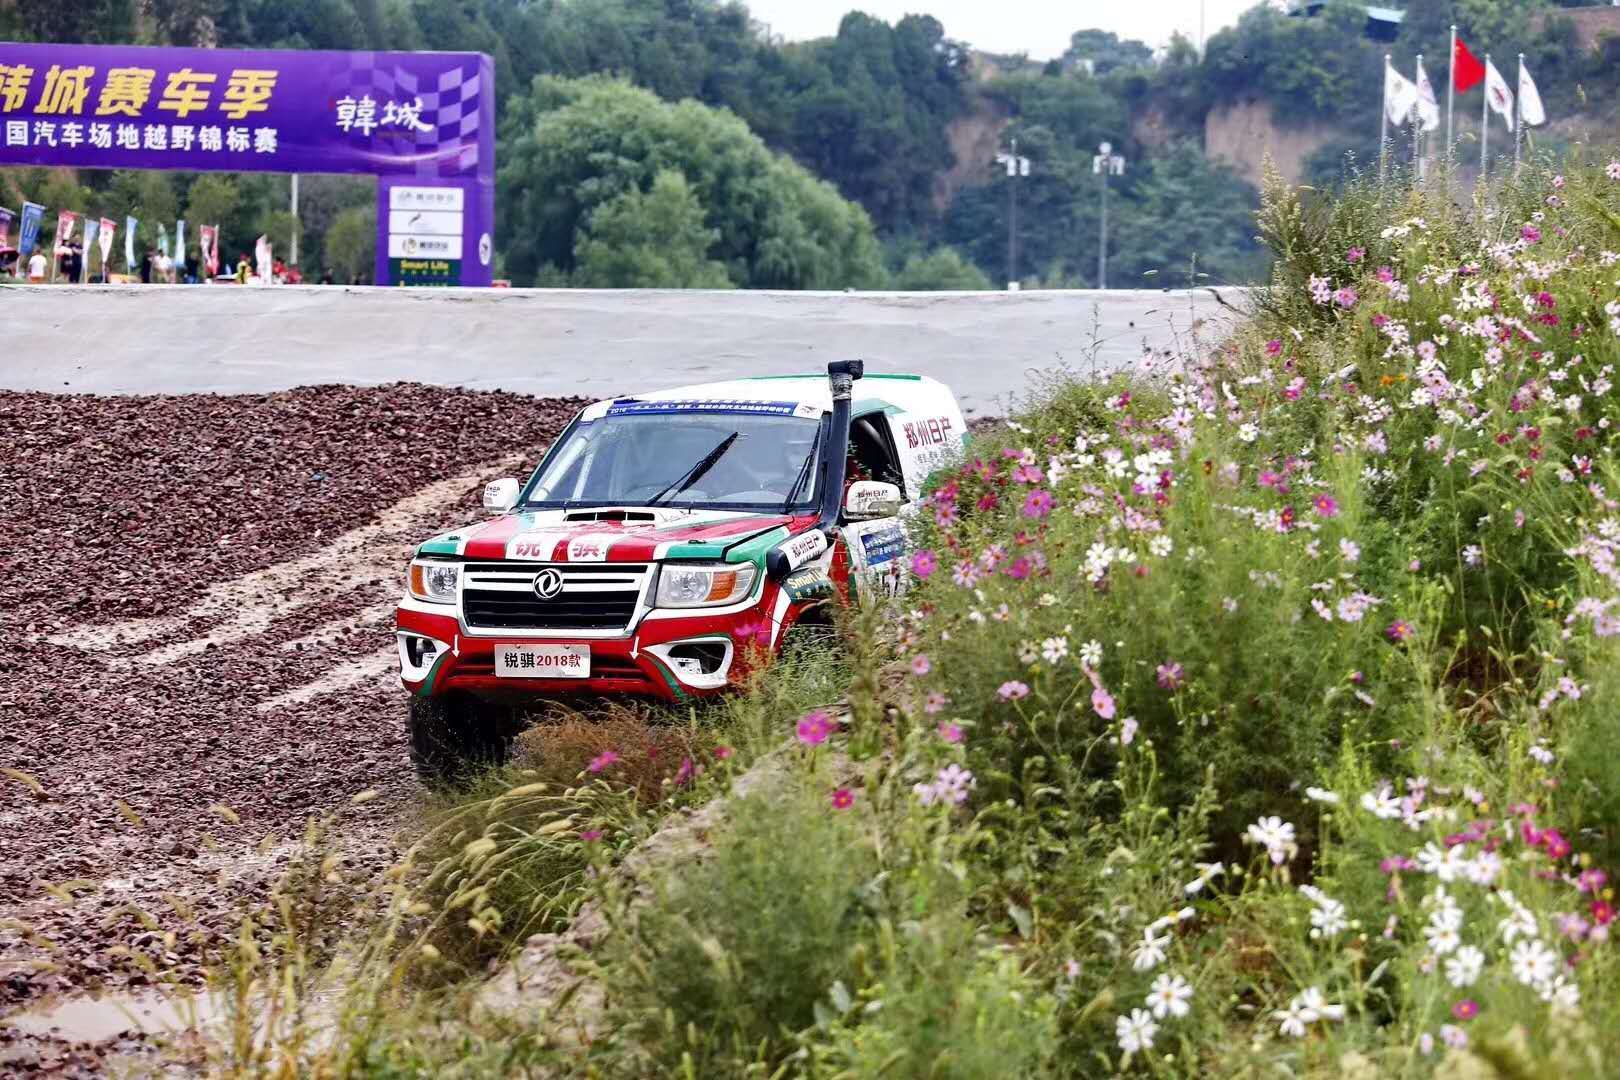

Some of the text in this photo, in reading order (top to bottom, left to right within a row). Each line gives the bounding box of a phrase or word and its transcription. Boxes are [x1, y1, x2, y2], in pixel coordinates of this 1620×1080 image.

[903, 417, 952, 448] 郑州日产
[504, 653, 581, 668] 锐骐2018款
